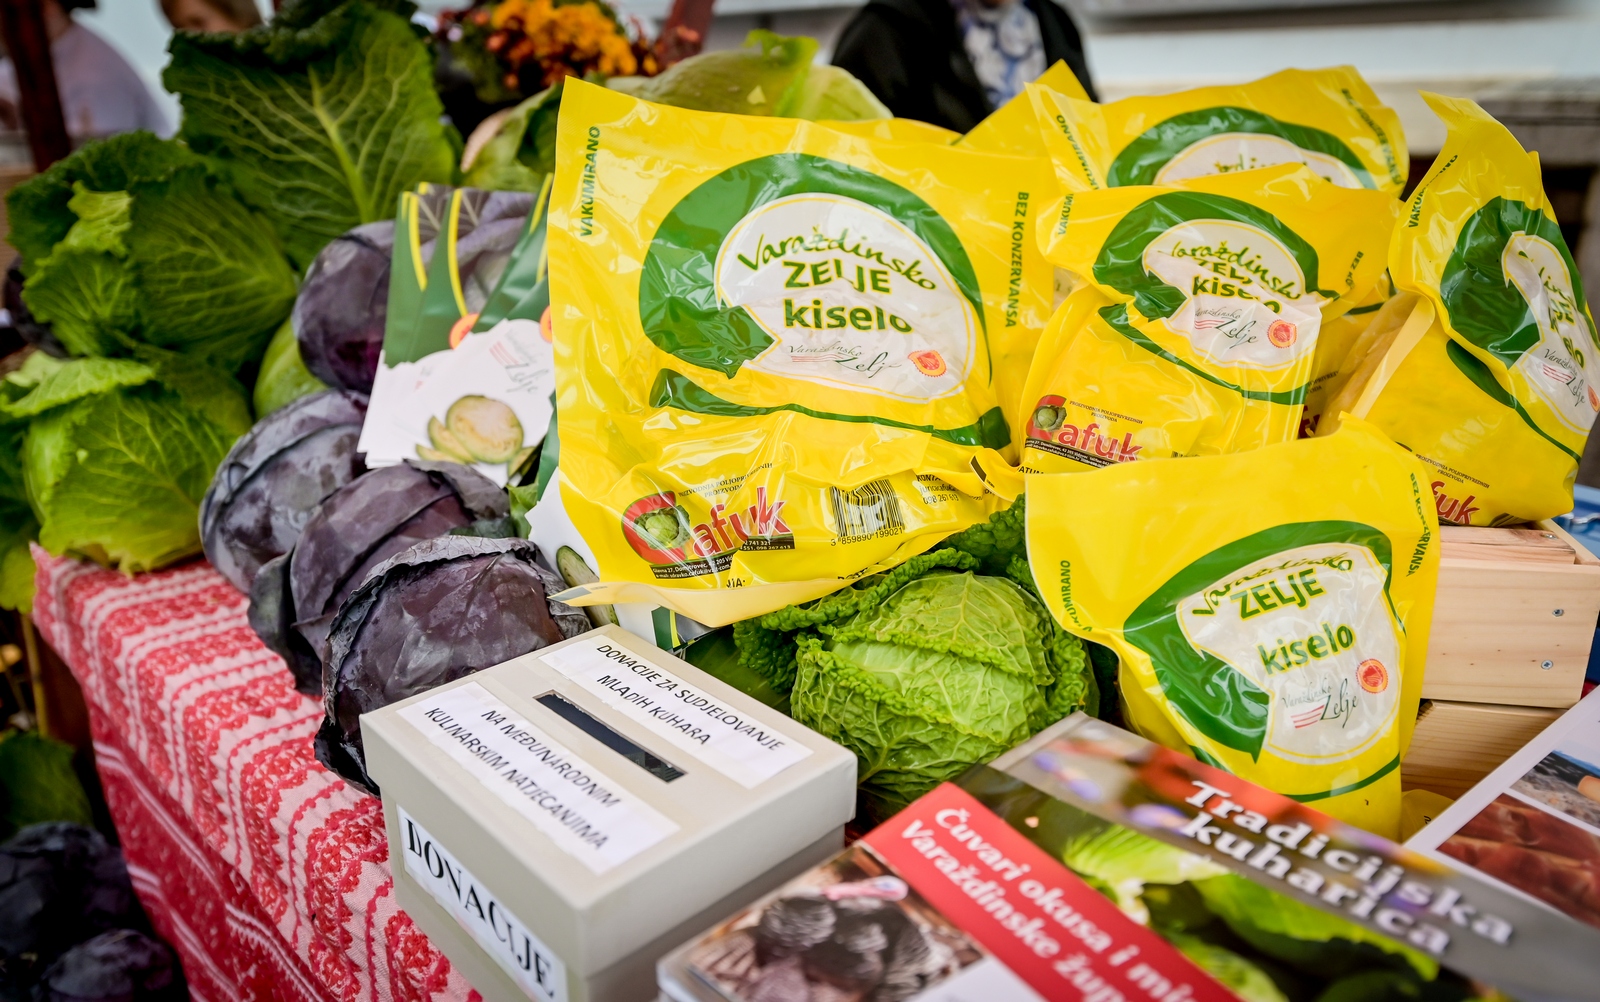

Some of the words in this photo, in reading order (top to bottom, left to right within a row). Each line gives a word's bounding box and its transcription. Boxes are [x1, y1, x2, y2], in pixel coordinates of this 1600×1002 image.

[580, 126, 600, 236] VAKUMIRANO
[1057, 114, 1099, 190] KUMIRANO
[1015, 192, 1029, 217] BEZ
[737, 224, 937, 290] Varaždinsko
[783, 257, 892, 294] ZELJE
[1005, 221, 1025, 328] KONZERVANSA
[784, 299, 914, 334] kiselo
[1215, 318, 1260, 351] Zelje
[1060, 560, 1092, 632] VKUMIRANO
[1230, 567, 1325, 620] ZELJE
[1257, 623, 1354, 675] kiselo
[596, 644, 663, 683] DONACIJE
[655, 678, 679, 692] ZA
[675, 689, 786, 752] SUDJELOVANJE
[596, 674, 655, 709] MLADIH
[648, 706, 712, 746] KUHARA
[1319, 678, 1359, 729] Zelje
[424, 707, 510, 771] KULINARSKIM
[502, 769, 610, 851] NATJECANJIMA
[481, 710, 507, 726] NA
[500, 724, 622, 809] MEĐUNARODNIM
[902, 819, 1061, 958] Varaždinske
[935, 808, 1032, 882] Čuvari
[1018, 878, 1113, 953] okusa
[1108, 943, 1141, 967] i
[1181, 811, 1452, 957] kuharica
[1185, 779, 1515, 947] Tradicijska
[404, 817, 554, 998] DONACIJE
